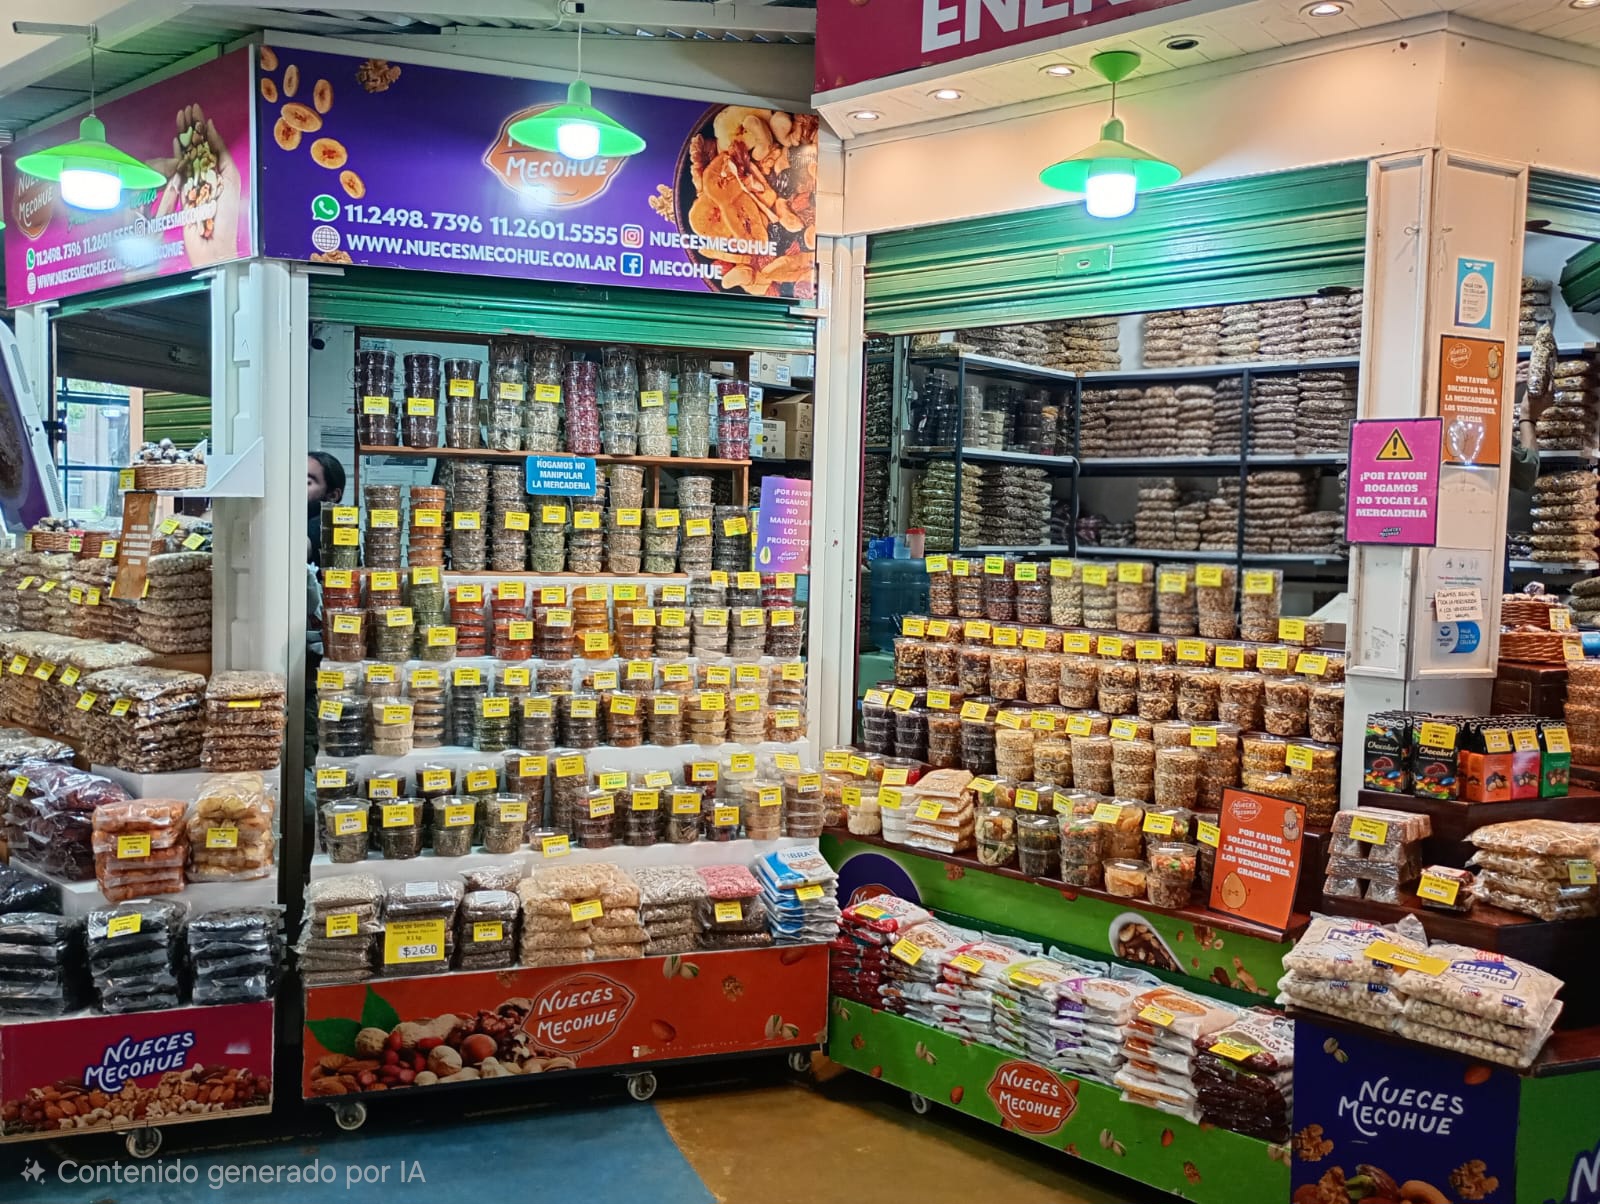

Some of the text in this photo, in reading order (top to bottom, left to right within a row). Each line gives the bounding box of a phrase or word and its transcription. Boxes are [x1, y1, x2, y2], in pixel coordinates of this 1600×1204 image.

[505, 155, 609, 187] MECOHUE
[19, 186, 54, 227] MECOHUE
[490, 216, 617, 245] 11.2601.5555
[346, 233, 616, 272] WWW.NUECESMECOHUE.COM.AR
[649, 231, 777, 257] NUECESMECOHUE
[649, 260, 722, 281] MECOHUE
[1456, 375, 1488, 385] POR FAVOR
[537, 459, 586, 470] ROGAMOS NO
[539, 470, 583, 480] MANIPULAR
[1360, 471, 1427, 482] ¡POR FAVOR!
[532, 479, 540, 489] LA
[1364, 484, 1418, 493] ROGAMOS
[775, 497, 809, 506] ROGAMOS
[1356, 496, 1428, 505] NO TOCAR LA
[783, 528, 798, 536] LOS
[1227, 835, 1291, 857] SOLICITAR TODA
[1238, 828, 1282, 845] POR FAVOR
[1221, 853, 1236, 862] LOS
[1223, 844, 1234, 853] LA
[1288, 860, 1295, 868] A
[538, 987, 613, 1016] NUECES
[537, 1008, 617, 1044] MECOHUE
[103, 1032, 194, 1066] NUECES
[85, 1051, 185, 1092] MECOHUE
[1000, 1069, 1059, 1097] NUECES
[999, 1090, 1062, 1118] MECOHUE
[1359, 1076, 1464, 1115] NUECES
[1338, 1095, 1453, 1137] MECOHUE
